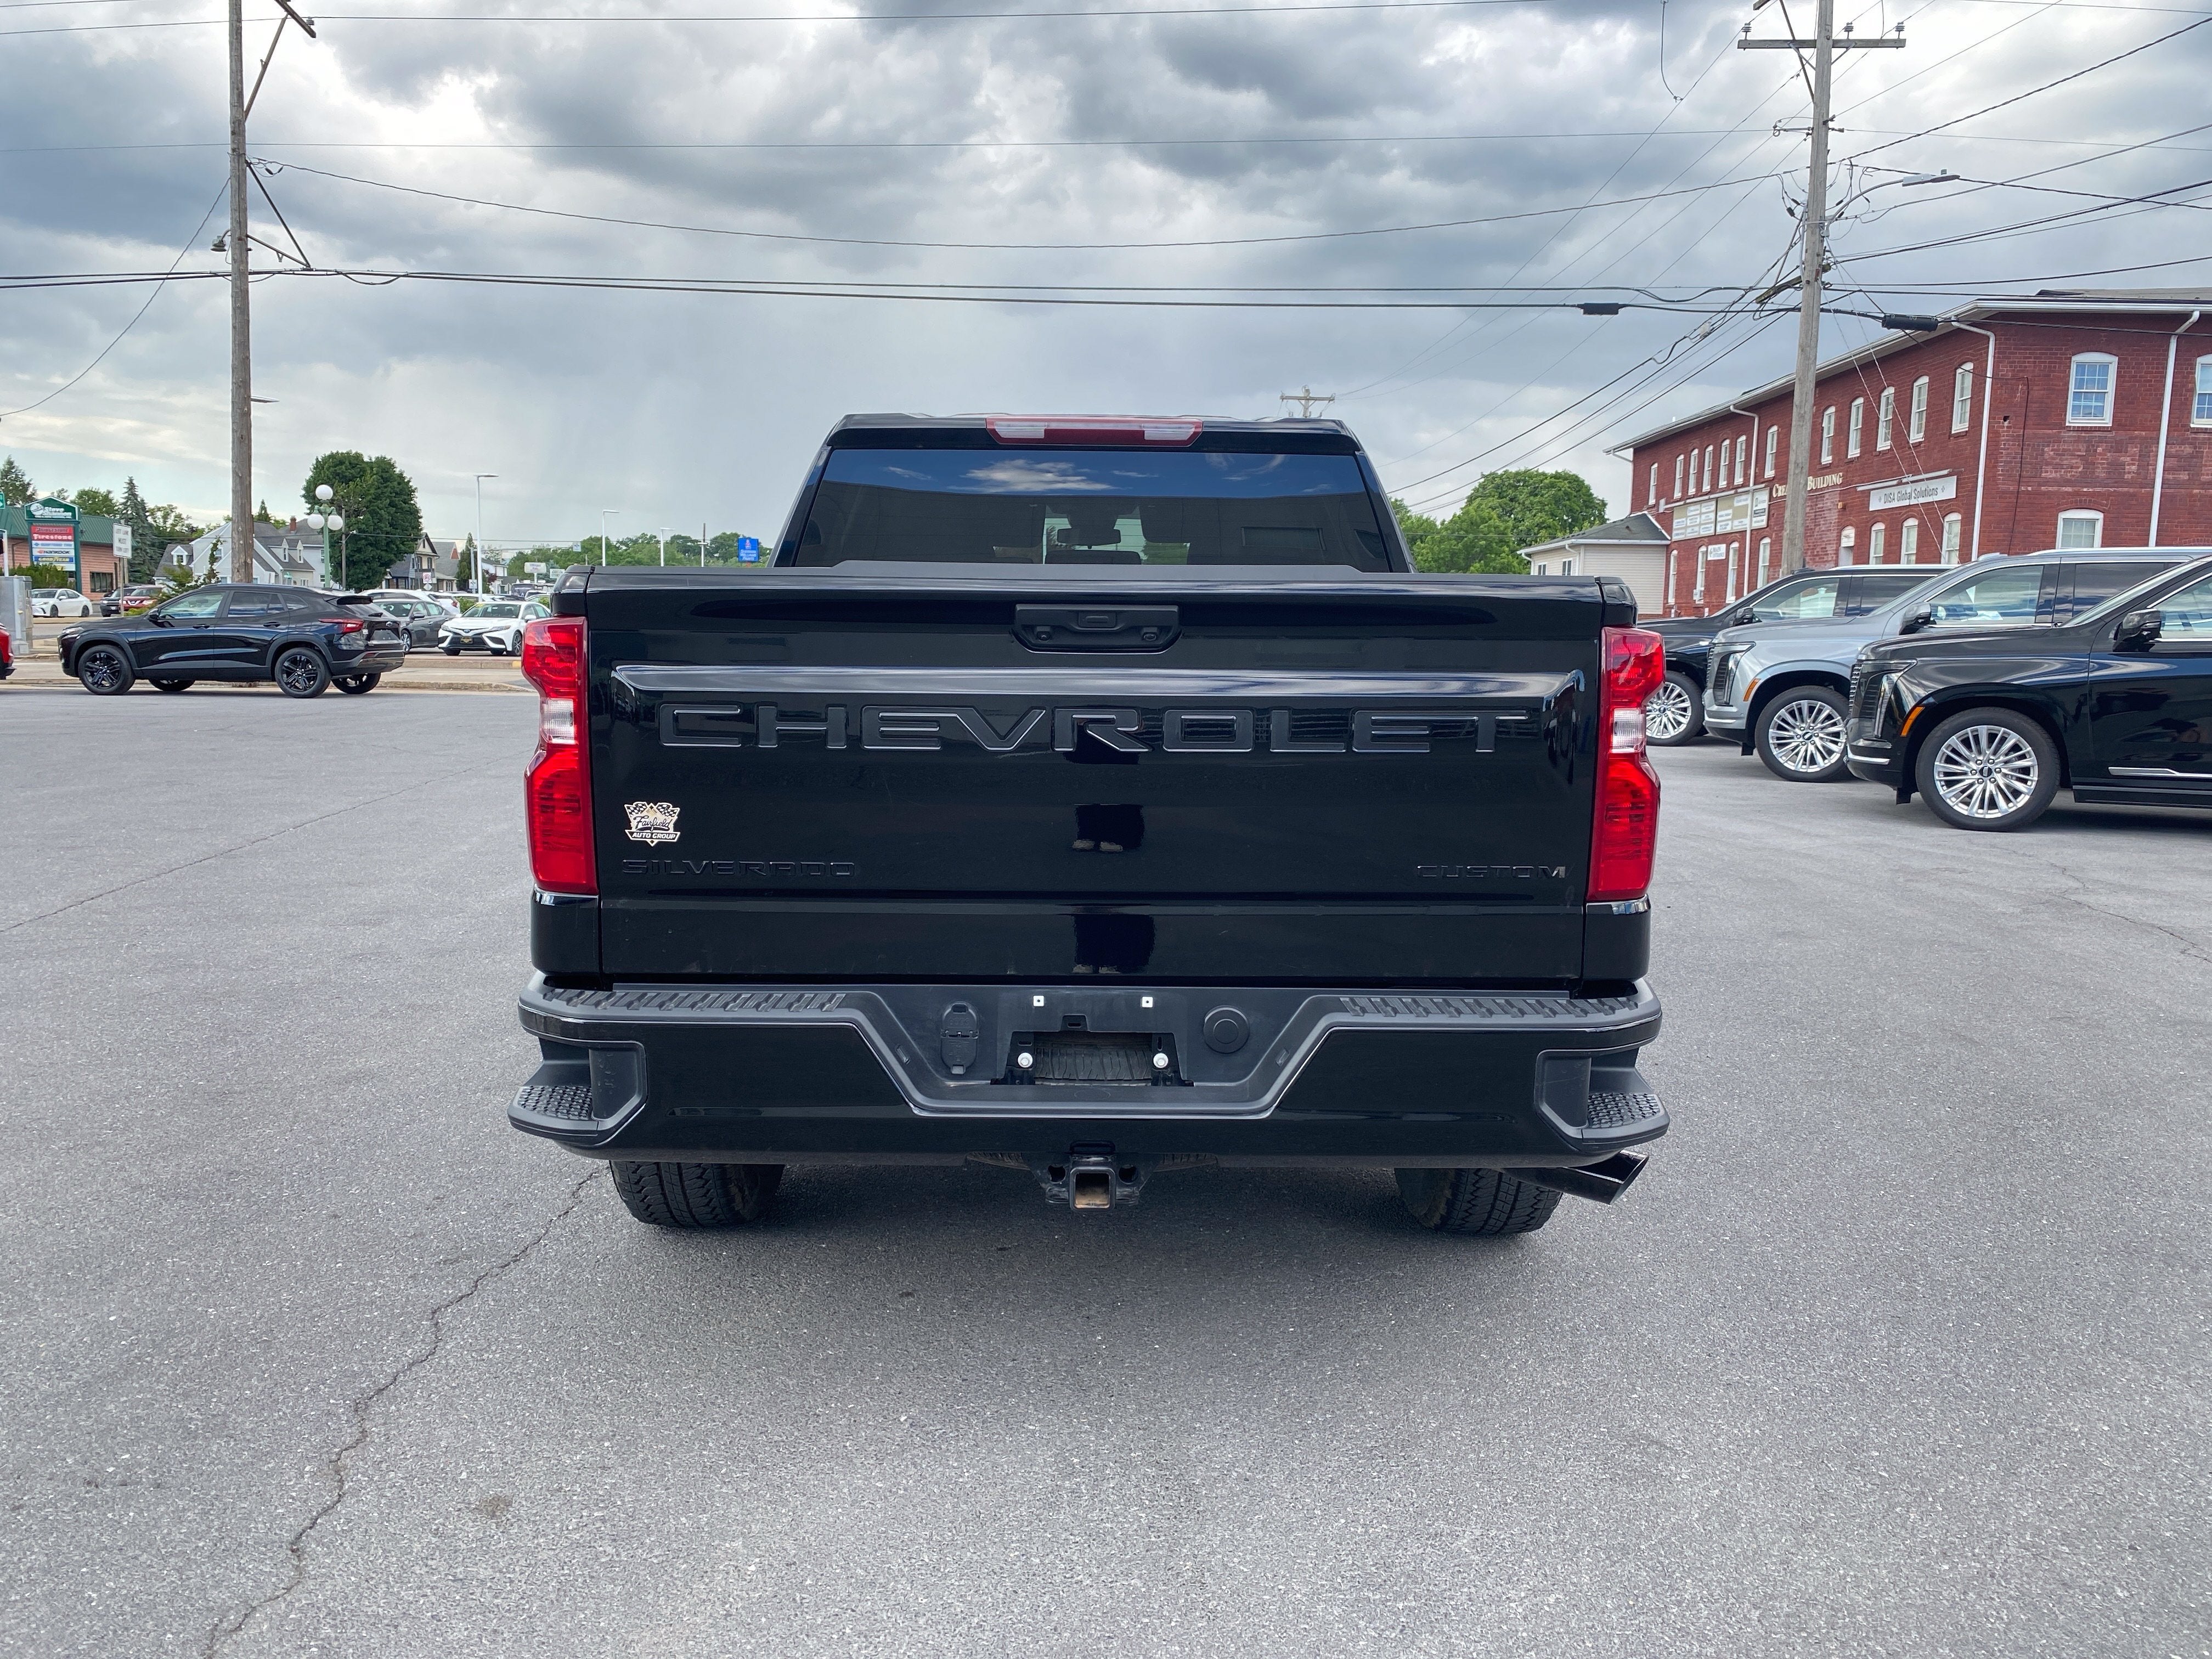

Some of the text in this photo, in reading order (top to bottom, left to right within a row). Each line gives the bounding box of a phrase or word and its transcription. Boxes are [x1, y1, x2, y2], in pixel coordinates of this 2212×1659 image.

[1807, 472, 1843, 491] BUILDING
[1884, 486, 1939, 504] DISA Global Solutions
[659, 703, 1529, 752] CHEVROLET
[633, 815, 673, 832] Fairfield
[623, 859, 855, 876] SILVERADO
[1417, 865, 1566, 878] CUSTOM
